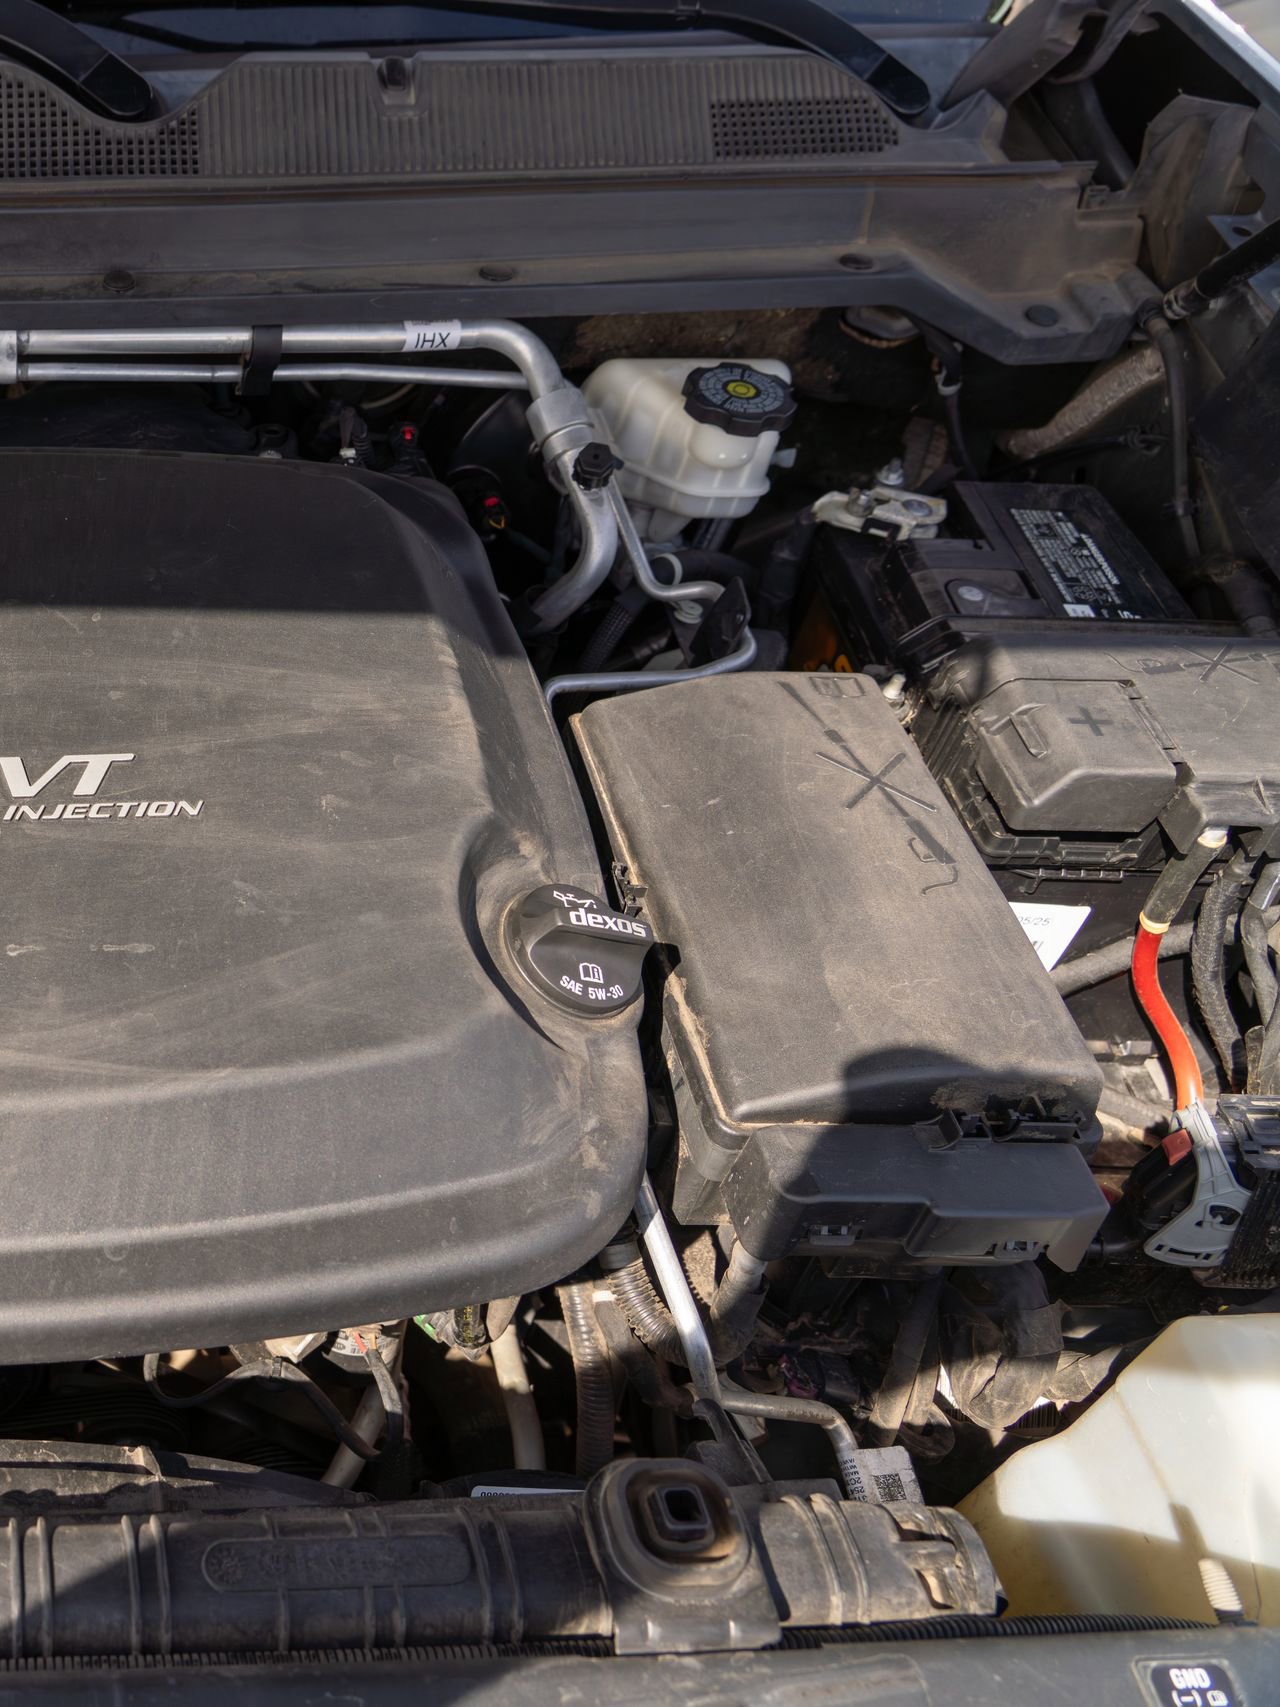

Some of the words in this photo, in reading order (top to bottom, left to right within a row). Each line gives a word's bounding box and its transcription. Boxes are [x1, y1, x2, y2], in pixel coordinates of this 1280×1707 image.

[414, 332, 451, 349] IHX
[3, 800, 206, 822] INJECTION
[569, 907, 646, 938] dexos
[559, 975, 583, 996] SAE
[588, 984, 624, 1001] 5W-30
[1168, 1667, 1212, 1689] GND
